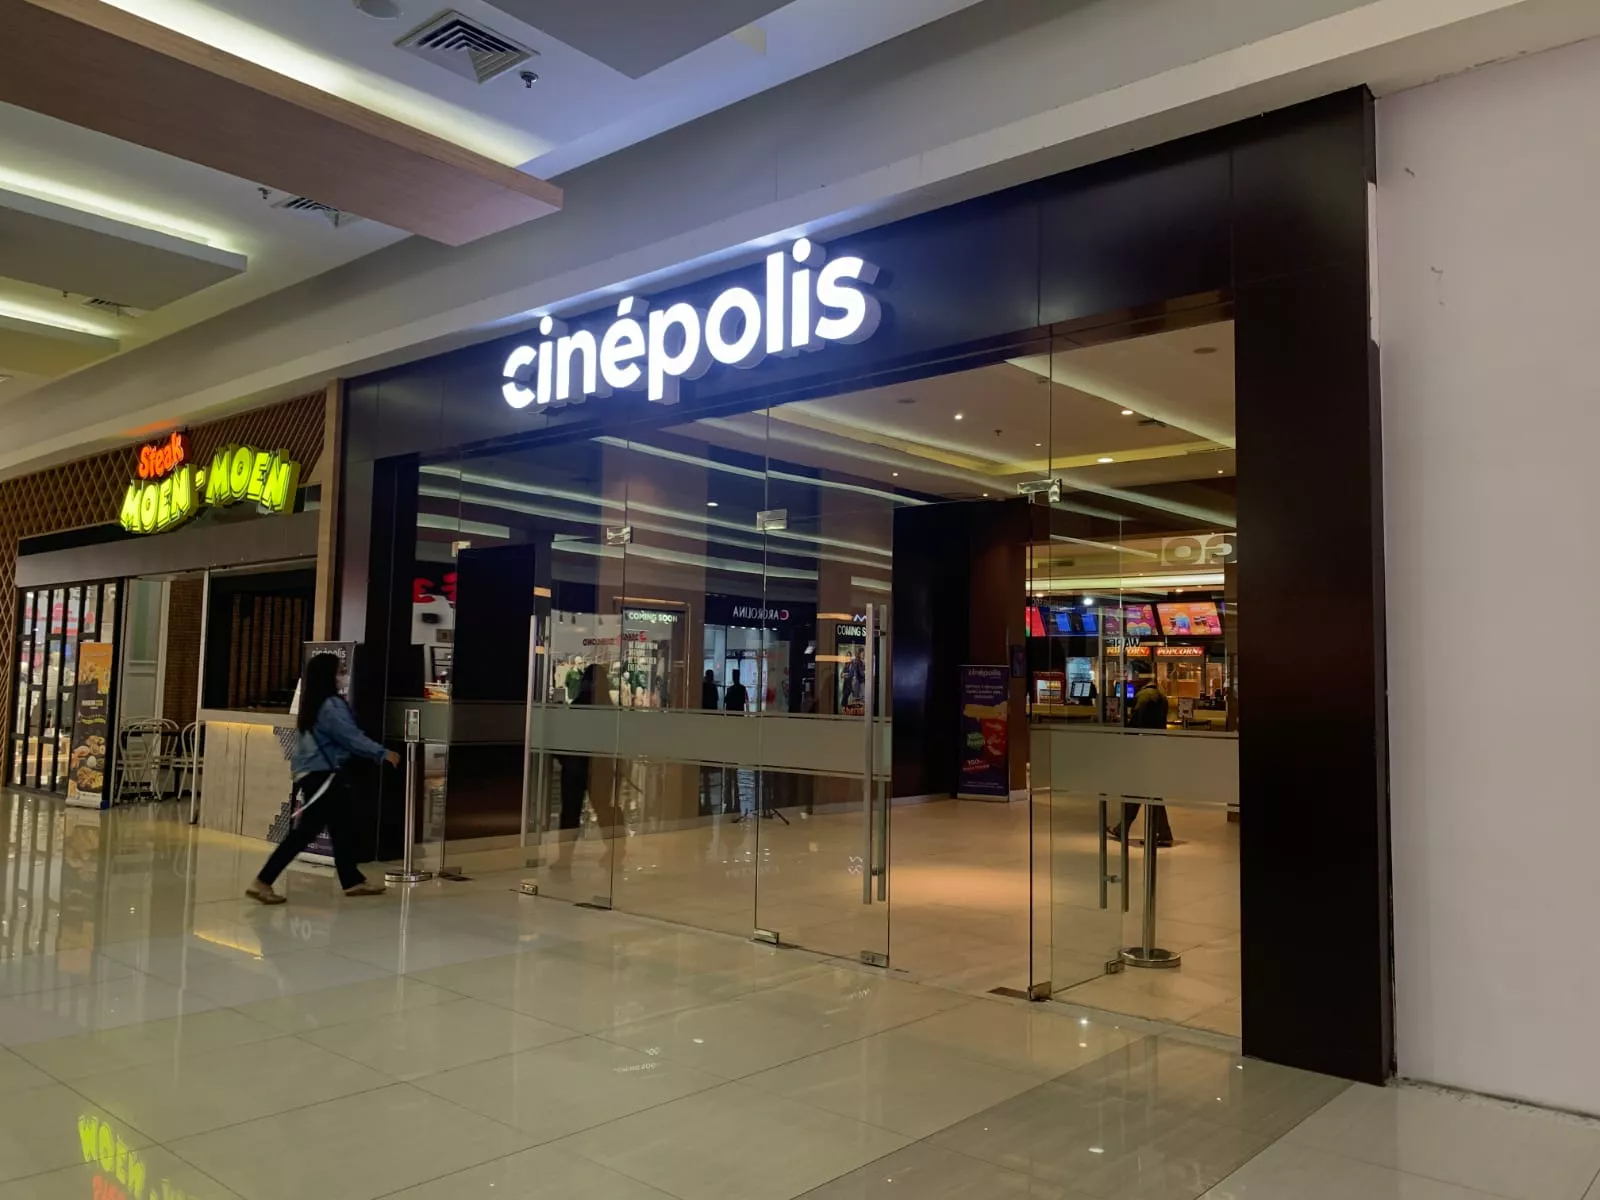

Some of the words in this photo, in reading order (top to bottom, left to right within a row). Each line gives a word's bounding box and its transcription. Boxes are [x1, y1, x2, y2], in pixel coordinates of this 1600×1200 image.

[502, 238, 867, 409] cinépolis
[139, 431, 184, 480] Steak
[1157, 647, 1199, 655] POPCORN
